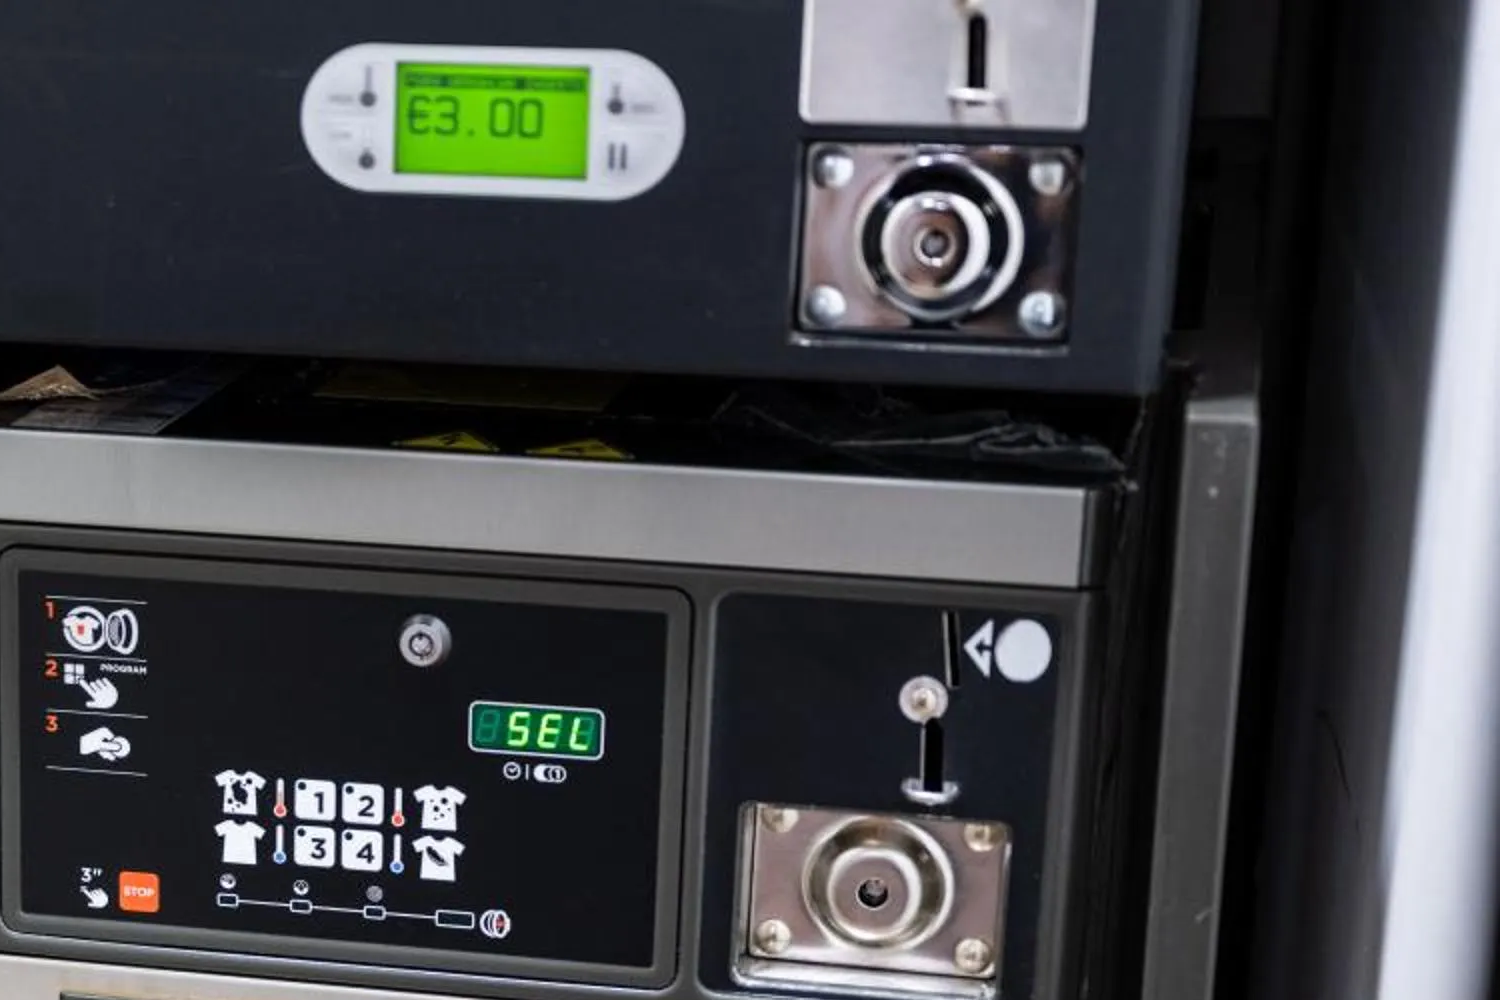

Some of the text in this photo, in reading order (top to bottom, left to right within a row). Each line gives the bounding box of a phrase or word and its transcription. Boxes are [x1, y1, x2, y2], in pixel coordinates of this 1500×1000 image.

[407, 93, 545, 139] €3.00
[45, 601, 55, 619] 1
[44, 660, 148, 678] 2 PROGRAM
[44, 714, 58, 732] 3
[507, 711, 589, 751] SEL
[312, 791, 375, 817] 1 2
[311, 838, 375, 864] 3 4
[123, 885, 155, 897] STOP
